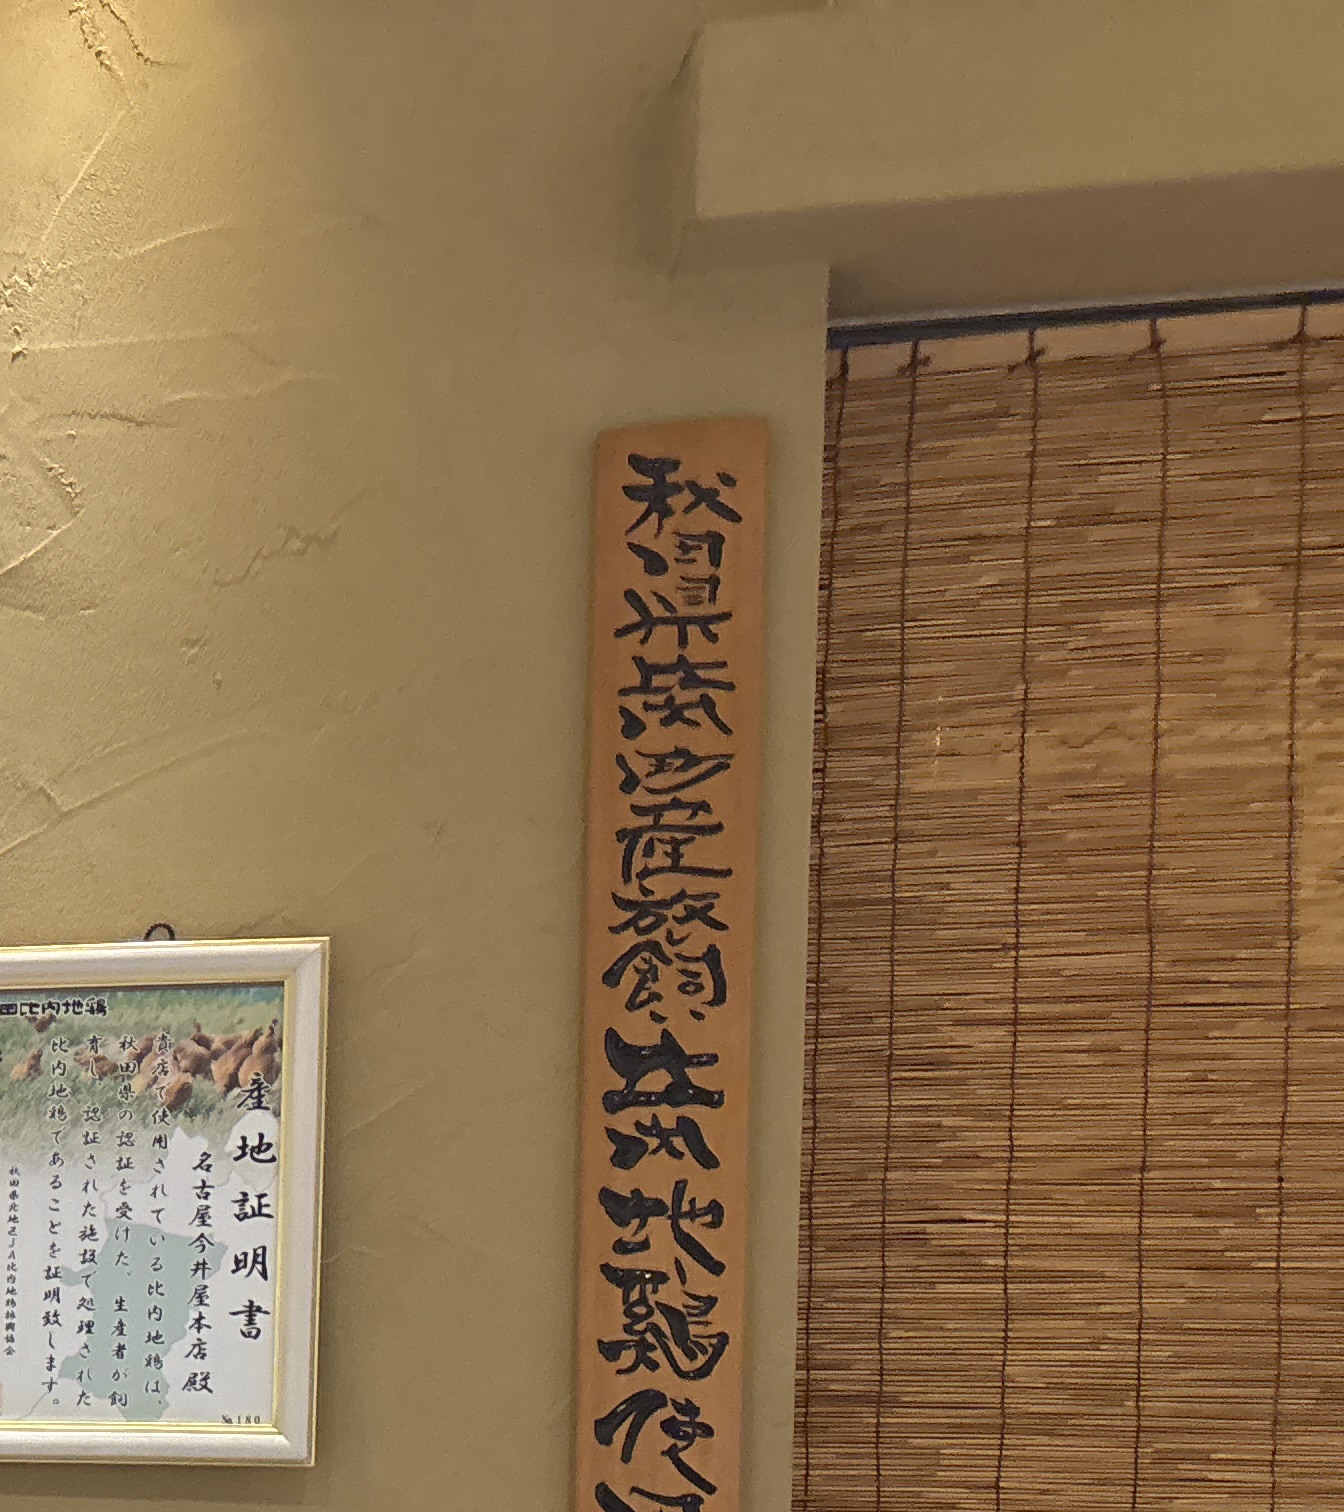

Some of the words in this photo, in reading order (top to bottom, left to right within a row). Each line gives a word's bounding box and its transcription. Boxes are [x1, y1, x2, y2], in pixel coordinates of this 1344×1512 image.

[181, 1151, 216, 1395] 名古屋今井屋本店殿
[229, 1072, 278, 1343] 産地証明書
